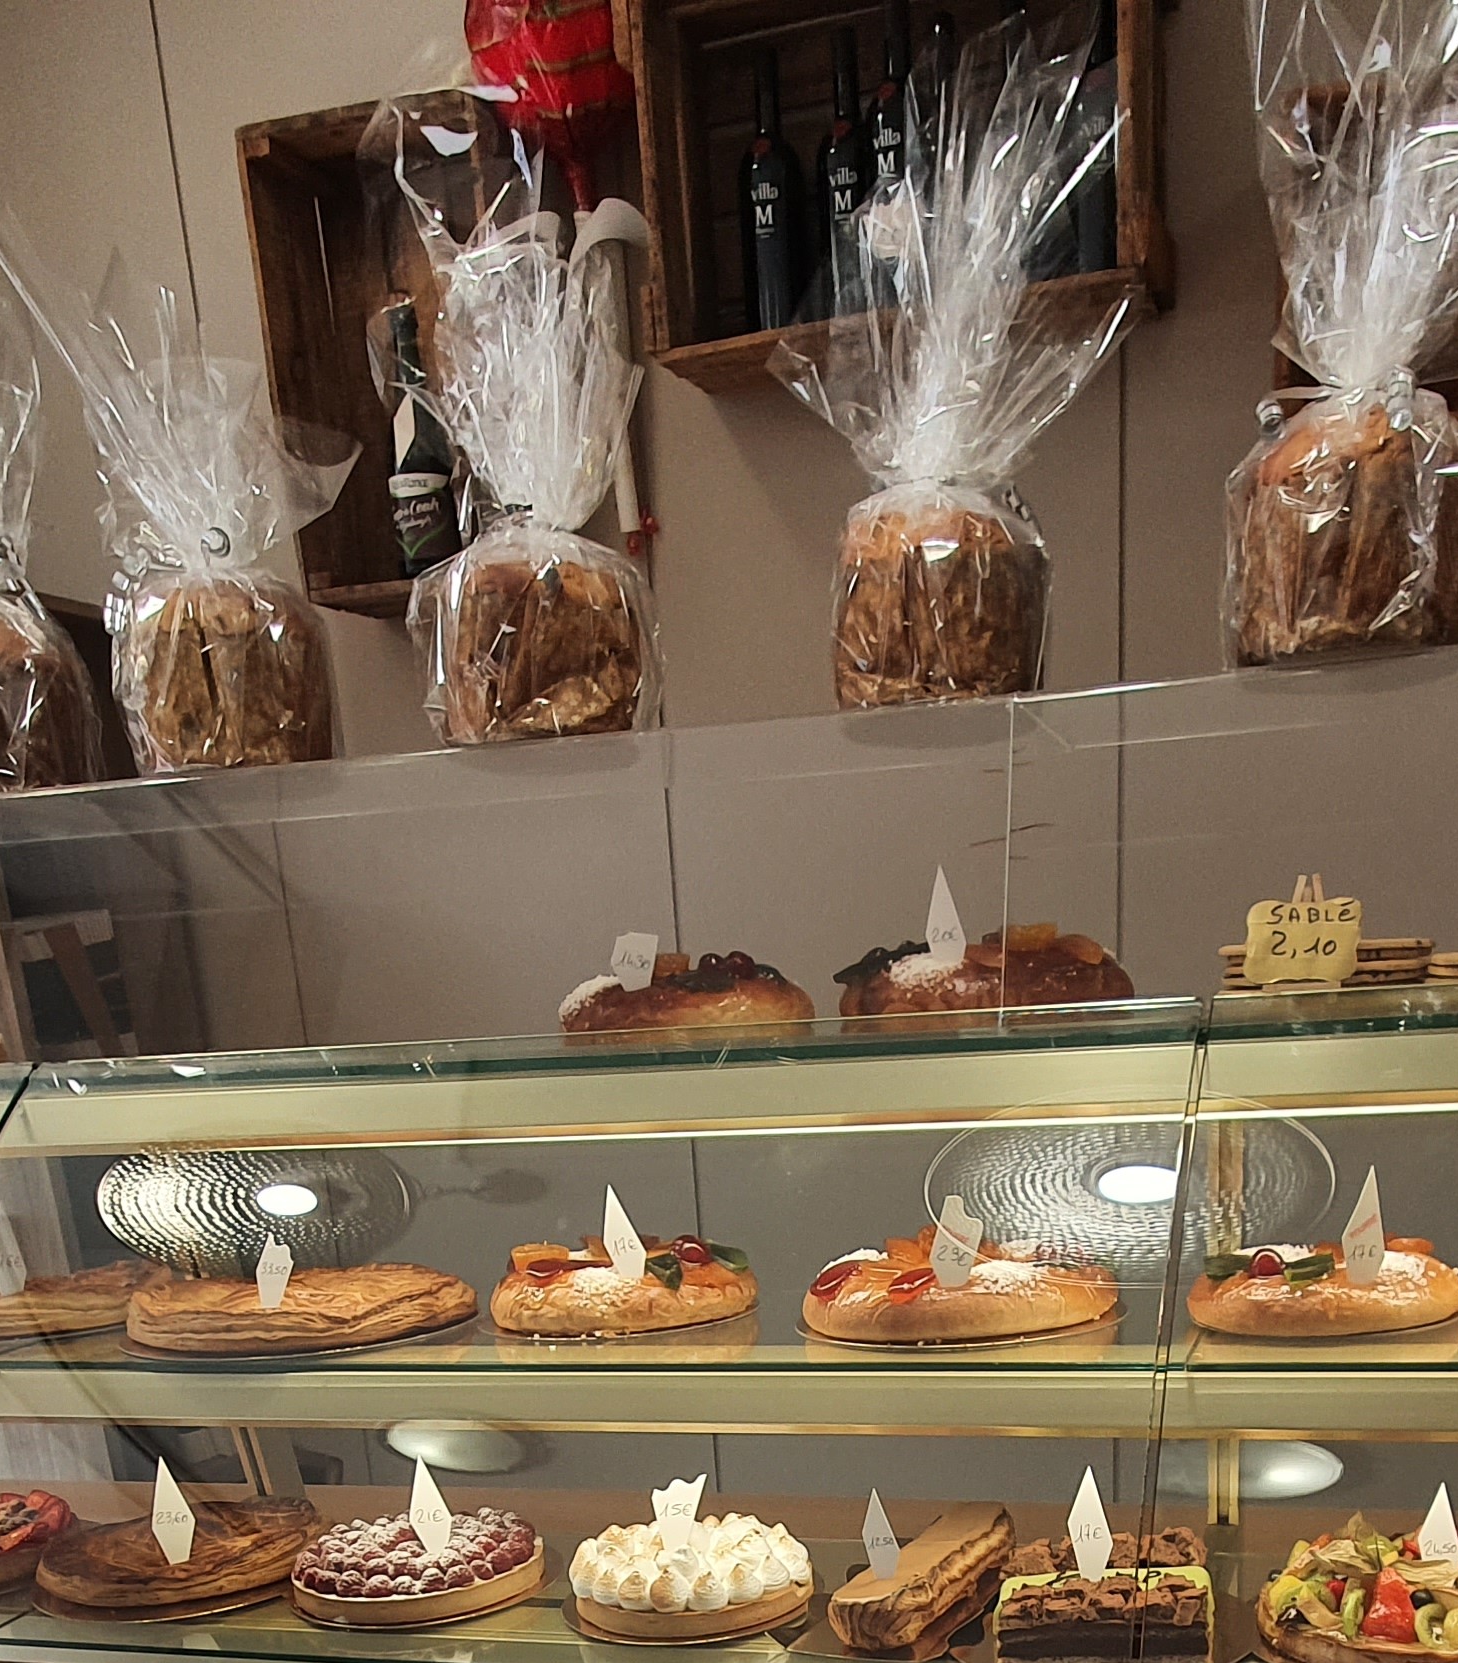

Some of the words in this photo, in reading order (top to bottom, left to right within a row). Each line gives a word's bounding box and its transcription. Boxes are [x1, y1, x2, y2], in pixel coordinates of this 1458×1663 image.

[872, 127, 902, 150] villa
[877, 151, 896, 175] M
[828, 167, 858, 187] villa
[750, 182, 779, 203] villa
[834, 189, 852, 212] M
[755, 204, 774, 227] M
[1270, 930, 1338, 960] 2,10
[612, 1239, 639, 1257] 17€
[1347, 1244, 1378, 1261] 17€
[415, 1508, 444, 1524] 21€
[658, 1503, 693, 1518] 15€
[1075, 1522, 1103, 1544] 17€
